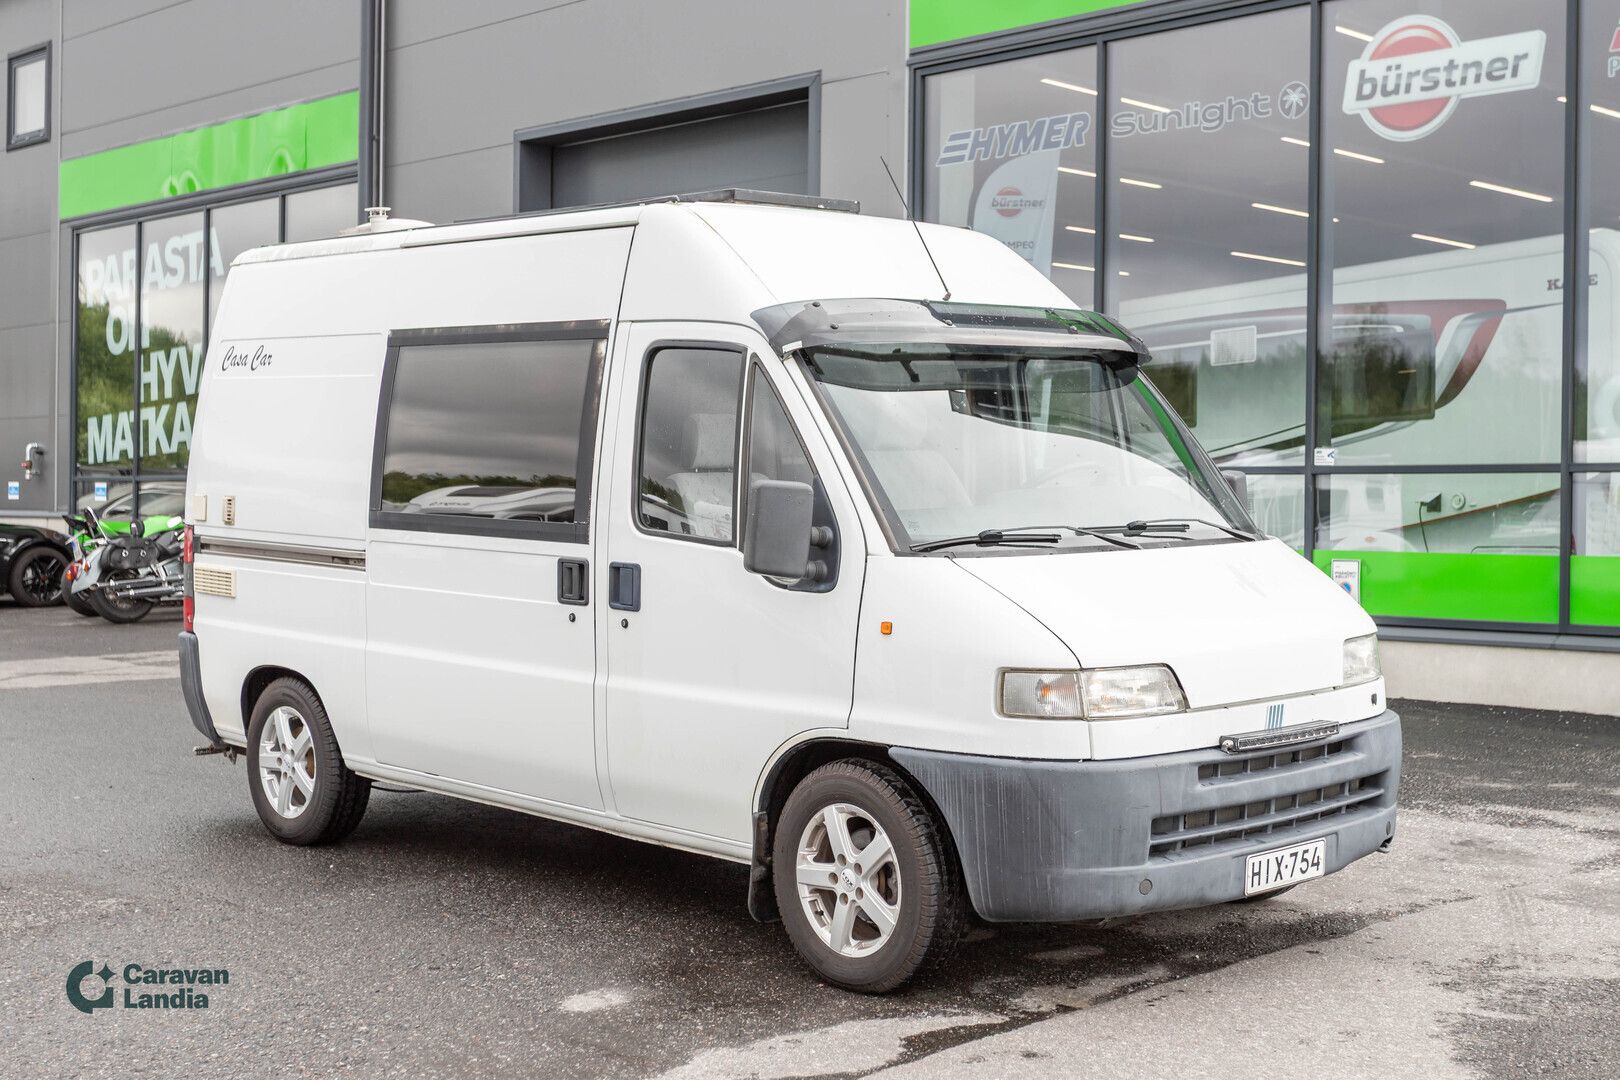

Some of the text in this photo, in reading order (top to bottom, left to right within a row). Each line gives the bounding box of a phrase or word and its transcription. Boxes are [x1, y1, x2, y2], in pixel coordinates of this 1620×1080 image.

[1355, 52, 1529, 102] bürstner
[966, 112, 1091, 162] HYMER
[1111, 92, 1272, 137] Sunlight
[991, 197, 1046, 209] bürstner
[140, 343, 204, 403] HYV
[221, 344, 273, 372] Casa Car
[1250, 846, 1321, 888] HIX-754
